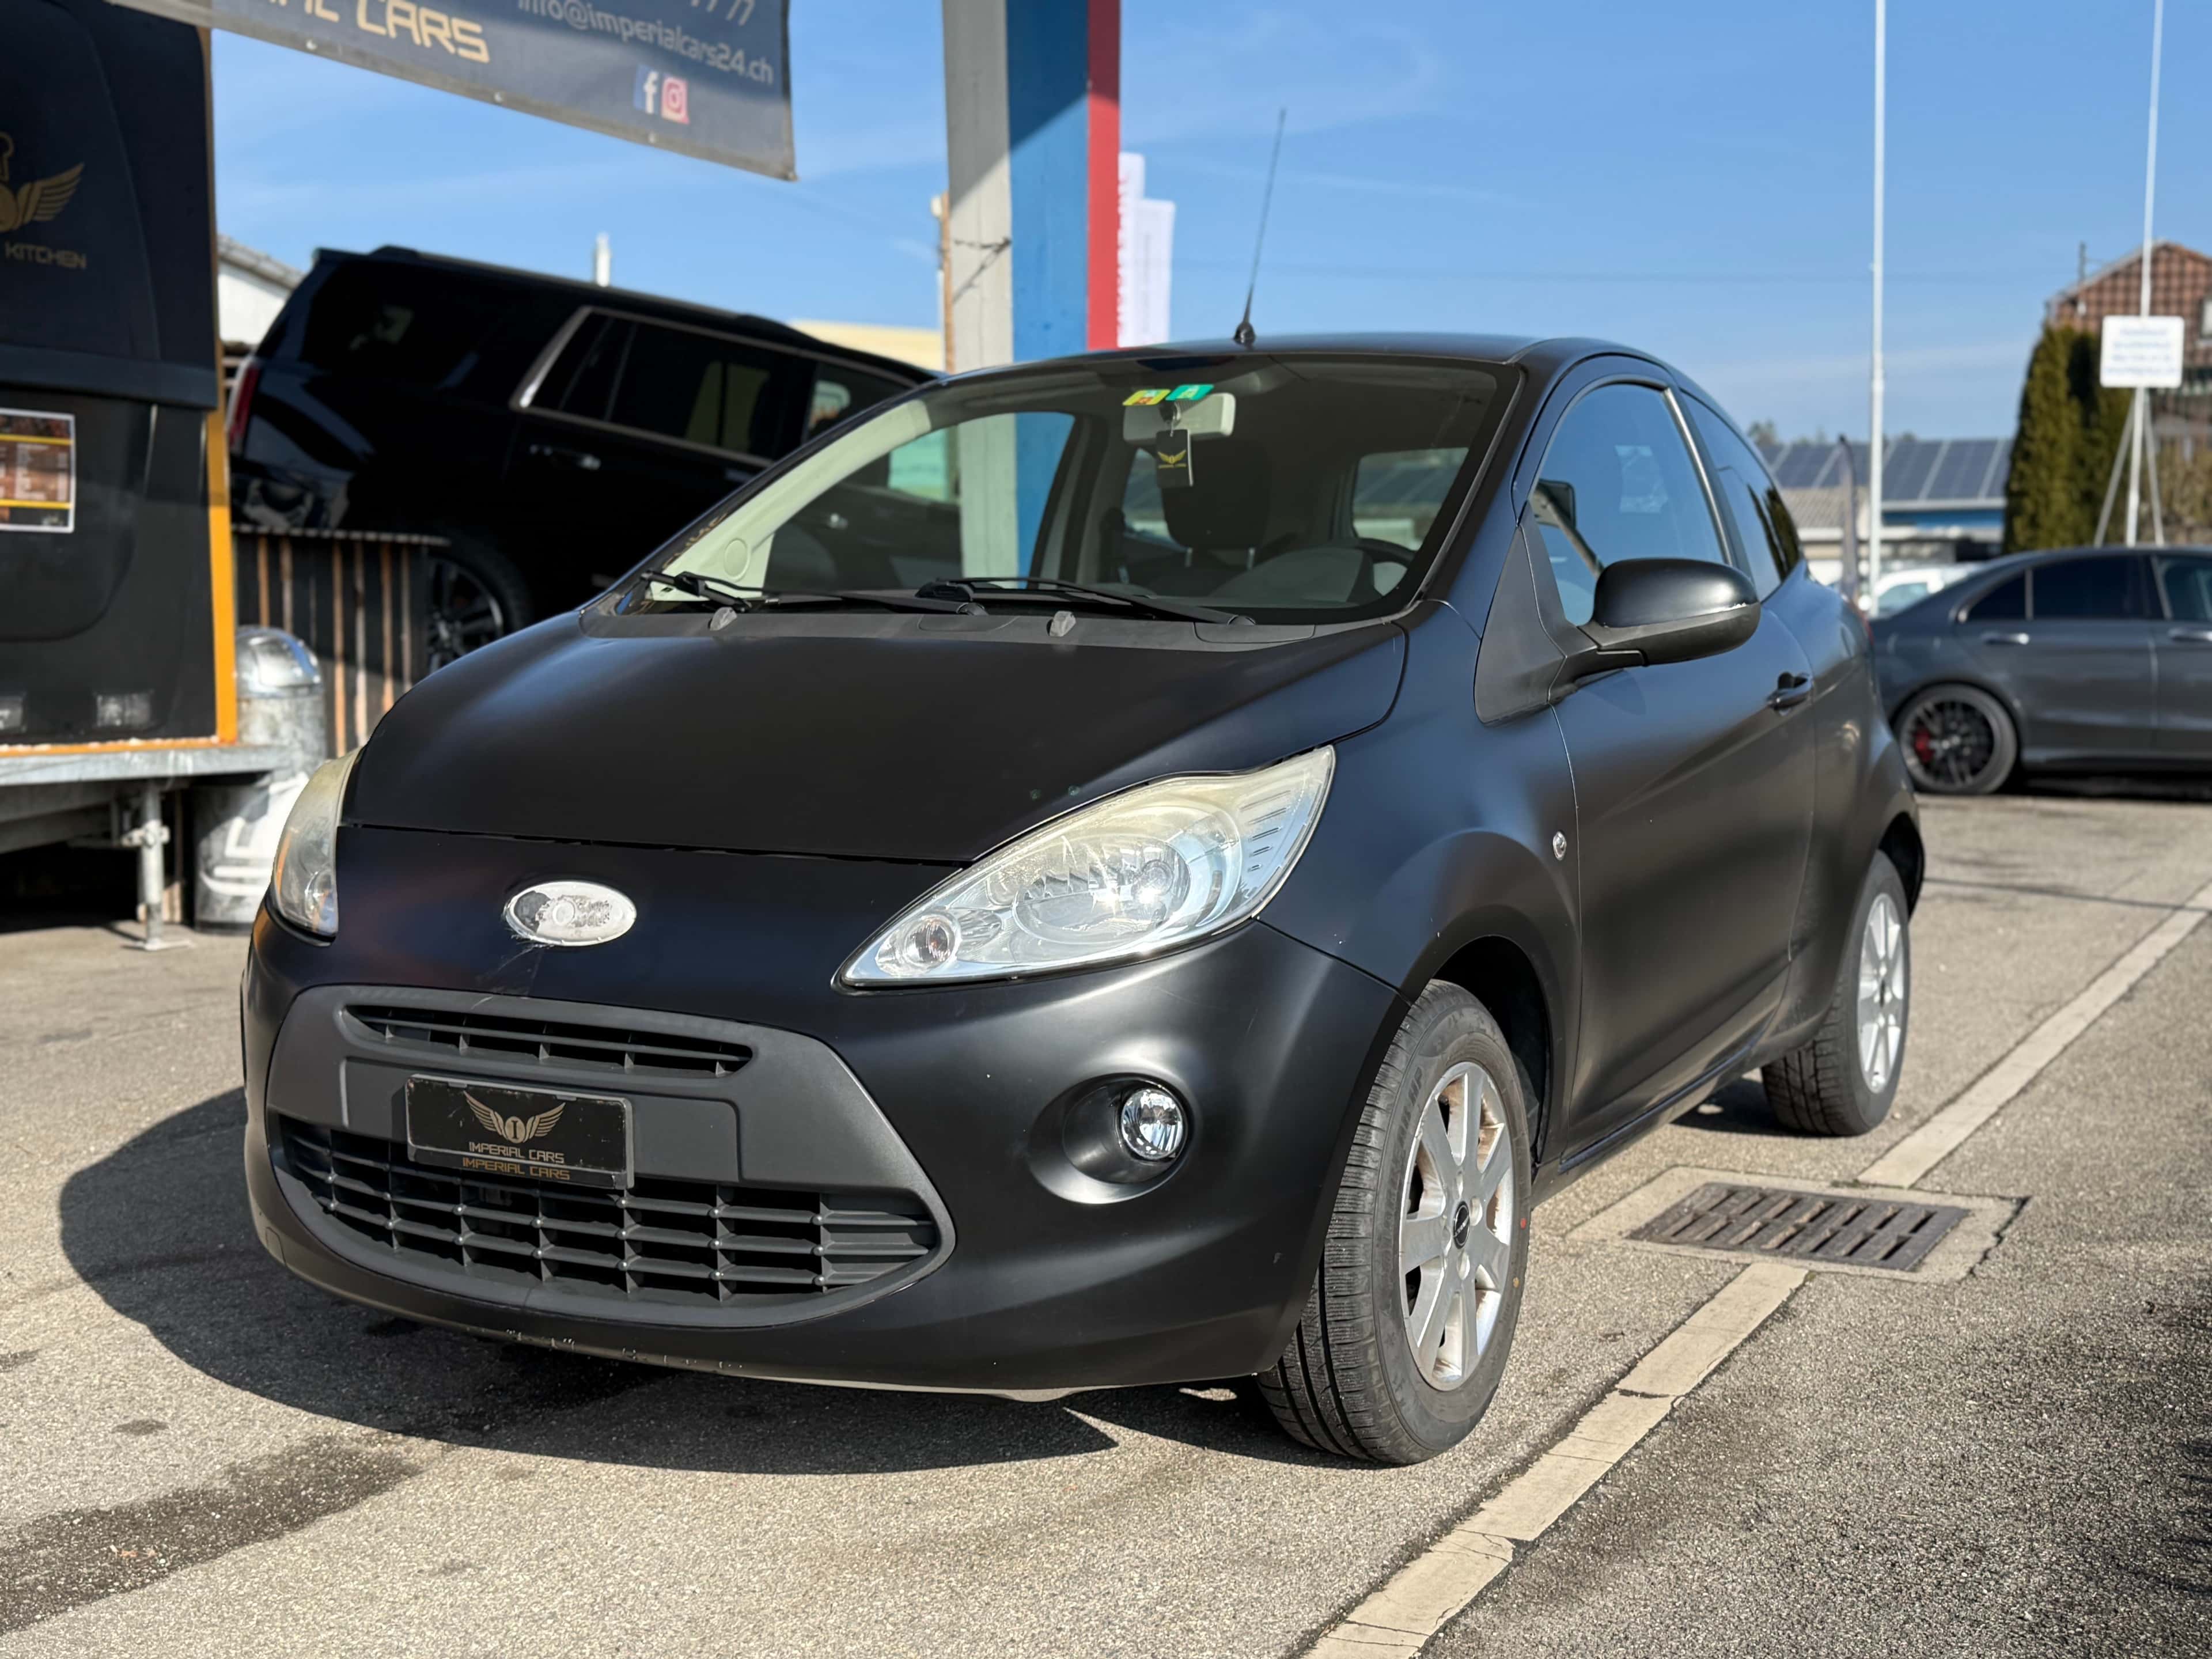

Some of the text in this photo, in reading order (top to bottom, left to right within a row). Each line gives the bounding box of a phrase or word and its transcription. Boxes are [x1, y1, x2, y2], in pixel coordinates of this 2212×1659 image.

[356, 0, 490, 63] CARS
[4, 240, 87, 270] KITCHEN
[469, 1141, 565, 1164] IMPERIAL CARS
[463, 1157, 571, 1181] IMPERIAL CARS
